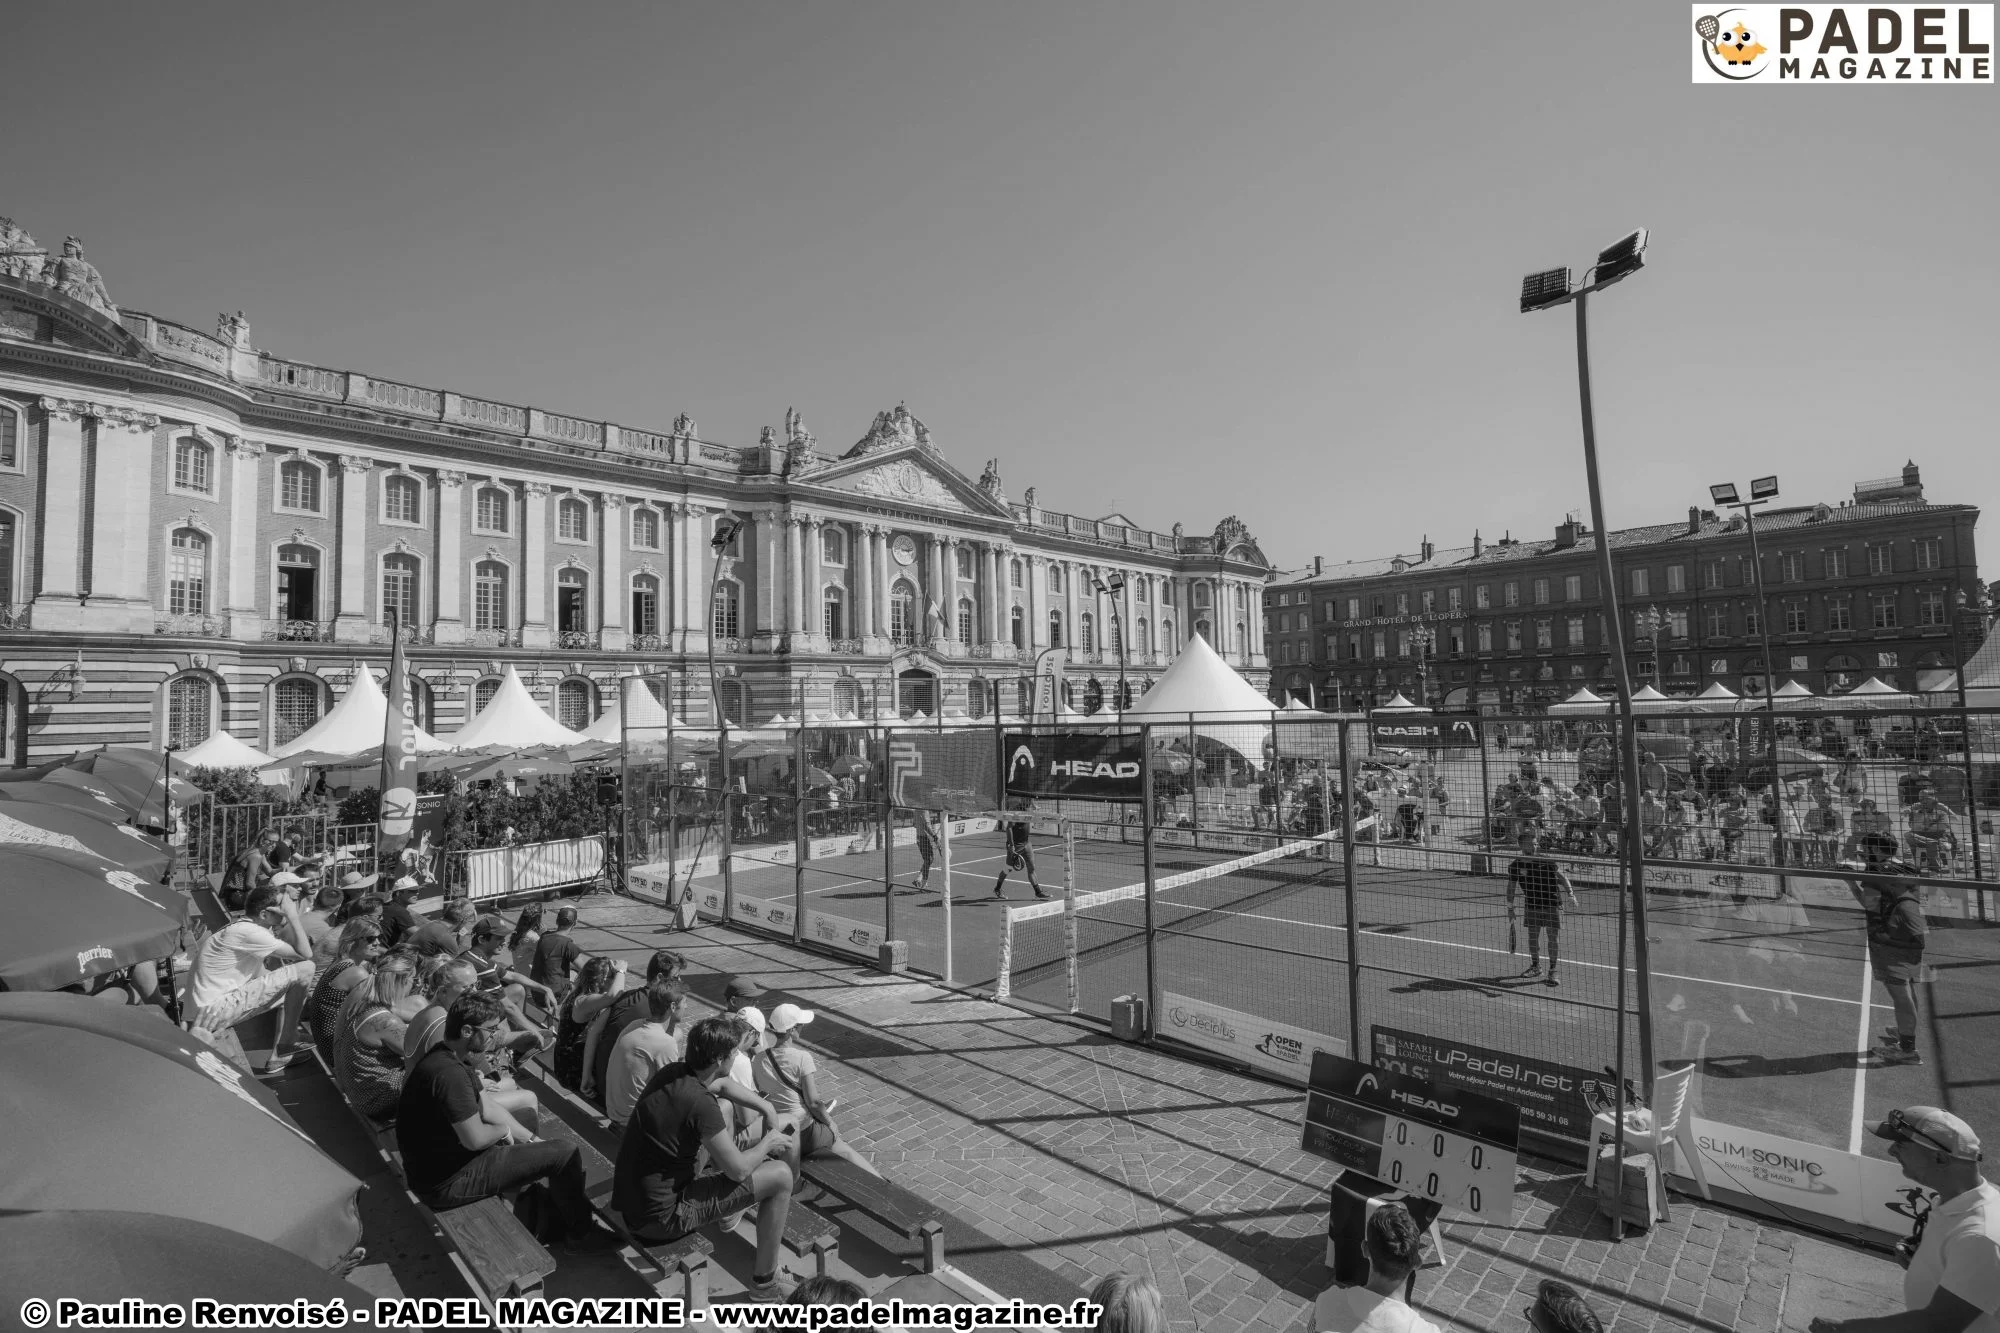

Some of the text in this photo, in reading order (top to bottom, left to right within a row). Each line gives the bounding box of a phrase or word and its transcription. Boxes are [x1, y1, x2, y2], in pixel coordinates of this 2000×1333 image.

[1343, 619, 1371, 628] GRAND
[1411, 615, 1423, 623] DE
[1043, 656, 1055, 709] TOULOUSE
[1050, 760, 1140, 779] HEAD
[416, 800, 441, 810] SONIC
[77, 945, 114, 974] perrier
[1189, 1015, 1236, 1039] Deciplus
[1275, 1036, 1302, 1050] OPEN
[1398, 1039, 1433, 1054] SAFARI
[1398, 1049, 1433, 1063] LOUNGE
[1434, 1049, 1573, 1092] uPadel.net
[1448, 1070, 1465, 1082] Votre
[1466, 1074, 1487, 1087] séjour
[1487, 1079, 1506, 1091] Padel
[1516, 1087, 1555, 1102] Andalousie
[1390, 1089, 1459, 1117] HEAD
[1397, 1122, 1483, 1170] 0 0 0
[1698, 1135, 1823, 1177] SLIM SONIC
[1724, 1161, 1796, 1184] SWISS MADE
[1392, 1160, 1481, 1212] 0 0 0
